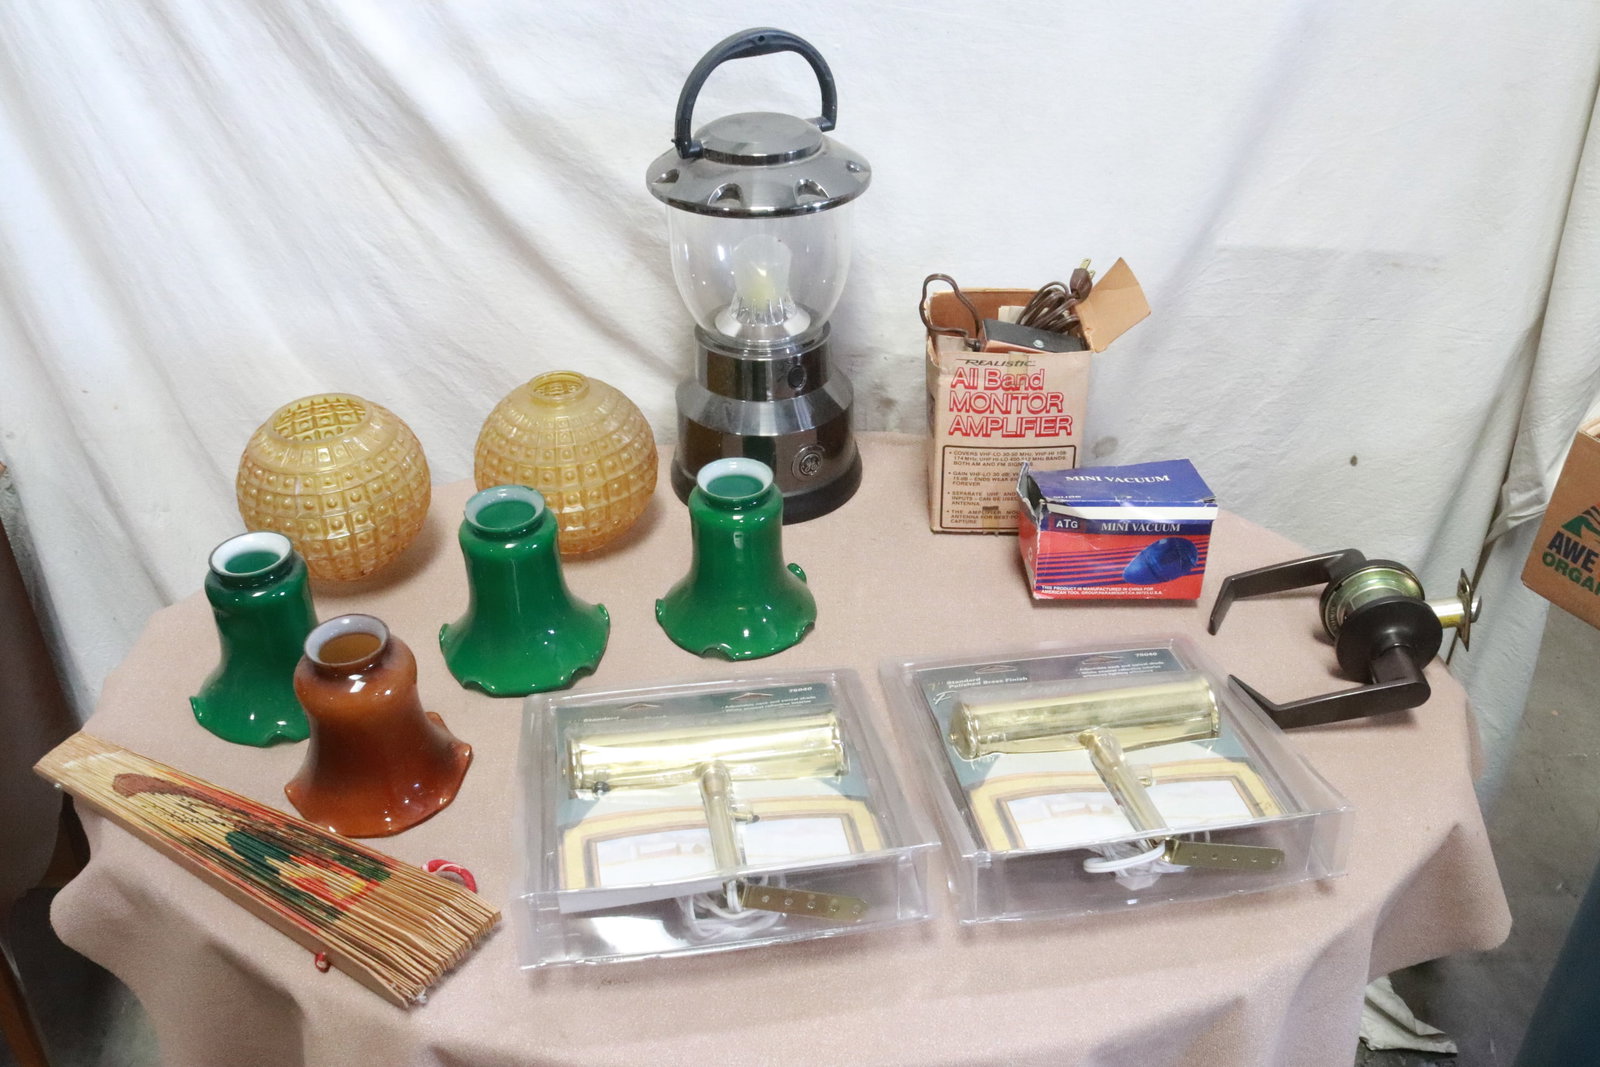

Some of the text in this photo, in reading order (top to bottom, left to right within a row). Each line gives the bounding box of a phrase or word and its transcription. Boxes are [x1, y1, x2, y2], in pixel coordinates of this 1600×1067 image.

[956, 358, 1036, 367] REALISTIC
[950, 367, 1045, 391] All Band
[949, 390, 1064, 414] MONITOR
[948, 415, 1073, 438] AMPLIFIER
[1103, 474, 1171, 483] VACUUM
[1056, 519, 1079, 529] ATG
[1101, 522, 1181, 532] MINI VACUUM
[1547, 530, 1600, 574] AWE
[946, 677, 981, 685] Standard
[948, 681, 981, 689] Polished
